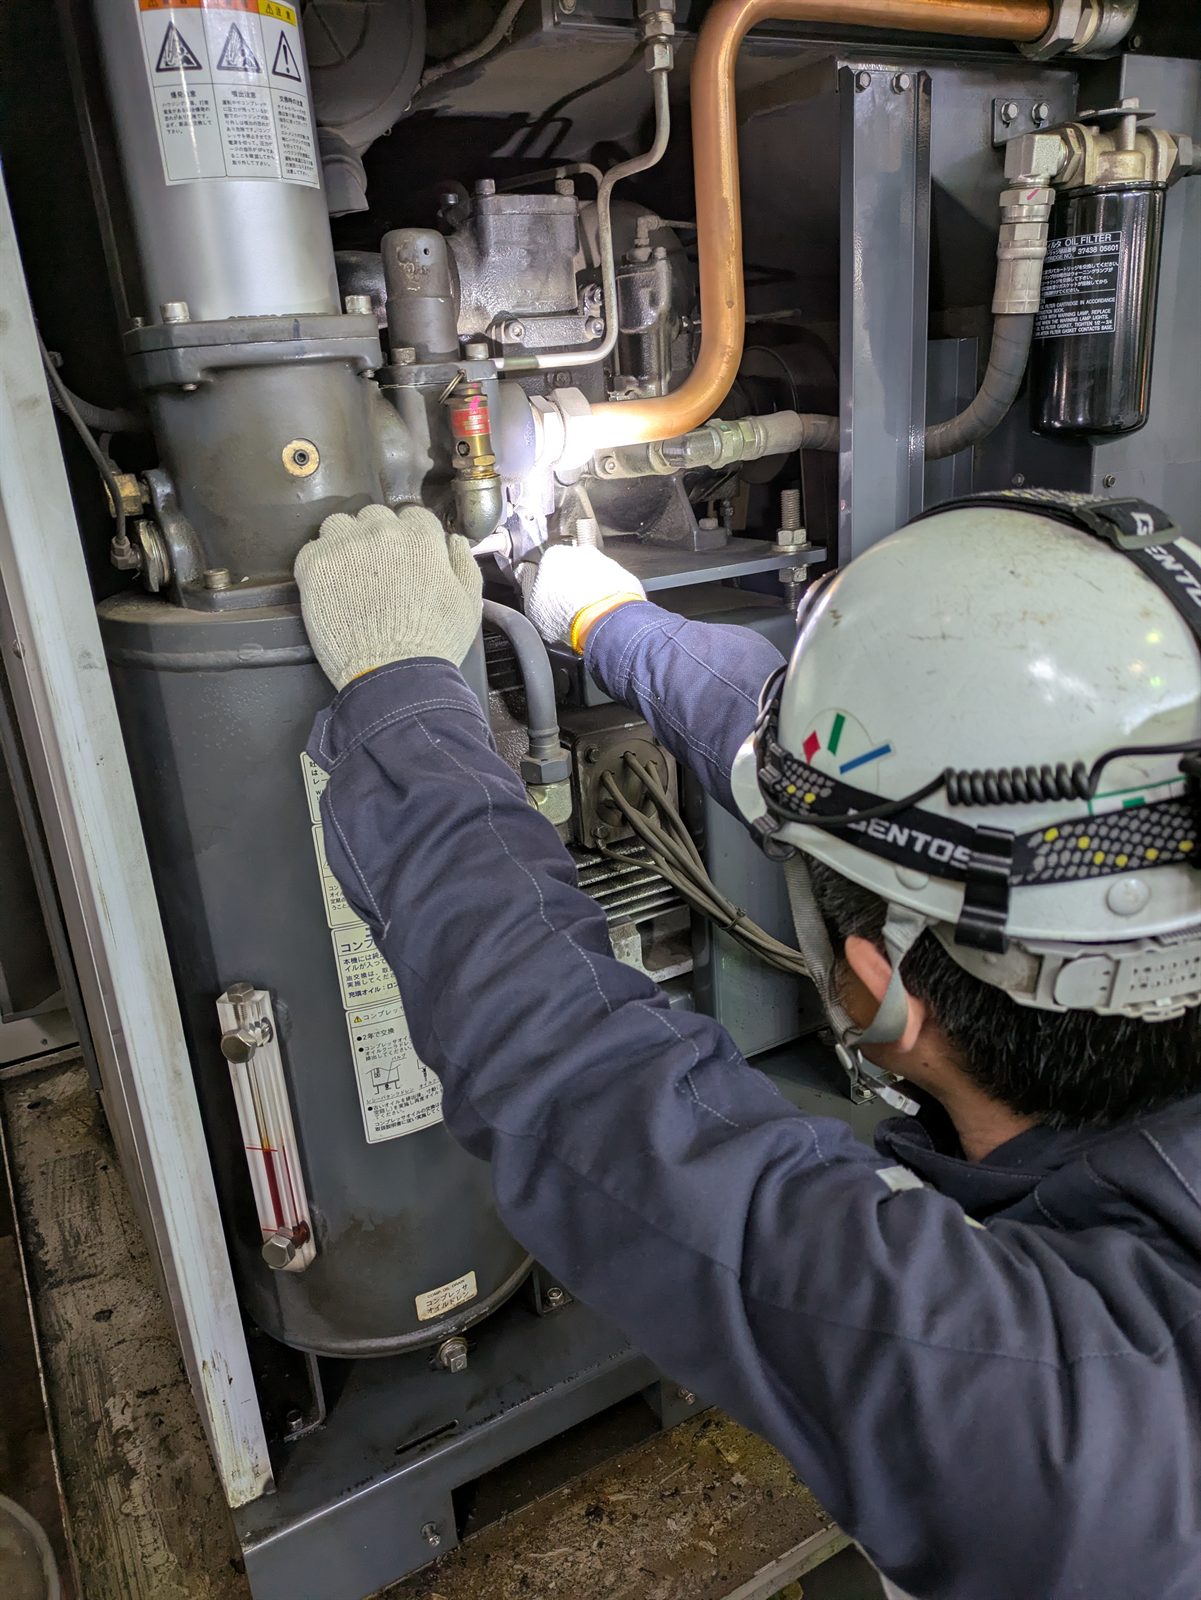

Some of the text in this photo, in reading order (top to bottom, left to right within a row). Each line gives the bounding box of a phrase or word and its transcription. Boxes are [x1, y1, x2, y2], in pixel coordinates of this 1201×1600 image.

[170, 90, 197, 98] 爆発意
[1065, 237, 1079, 246] OIL
[1081, 234, 1112, 244] FILTER
[1086, 297, 1115, 305] ACCORDANCE
[1057, 311, 1076, 319] WARNING
[426, 1284, 468, 1307] コンプレッサ
[427, 1291, 469, 1314] オイルドレン
